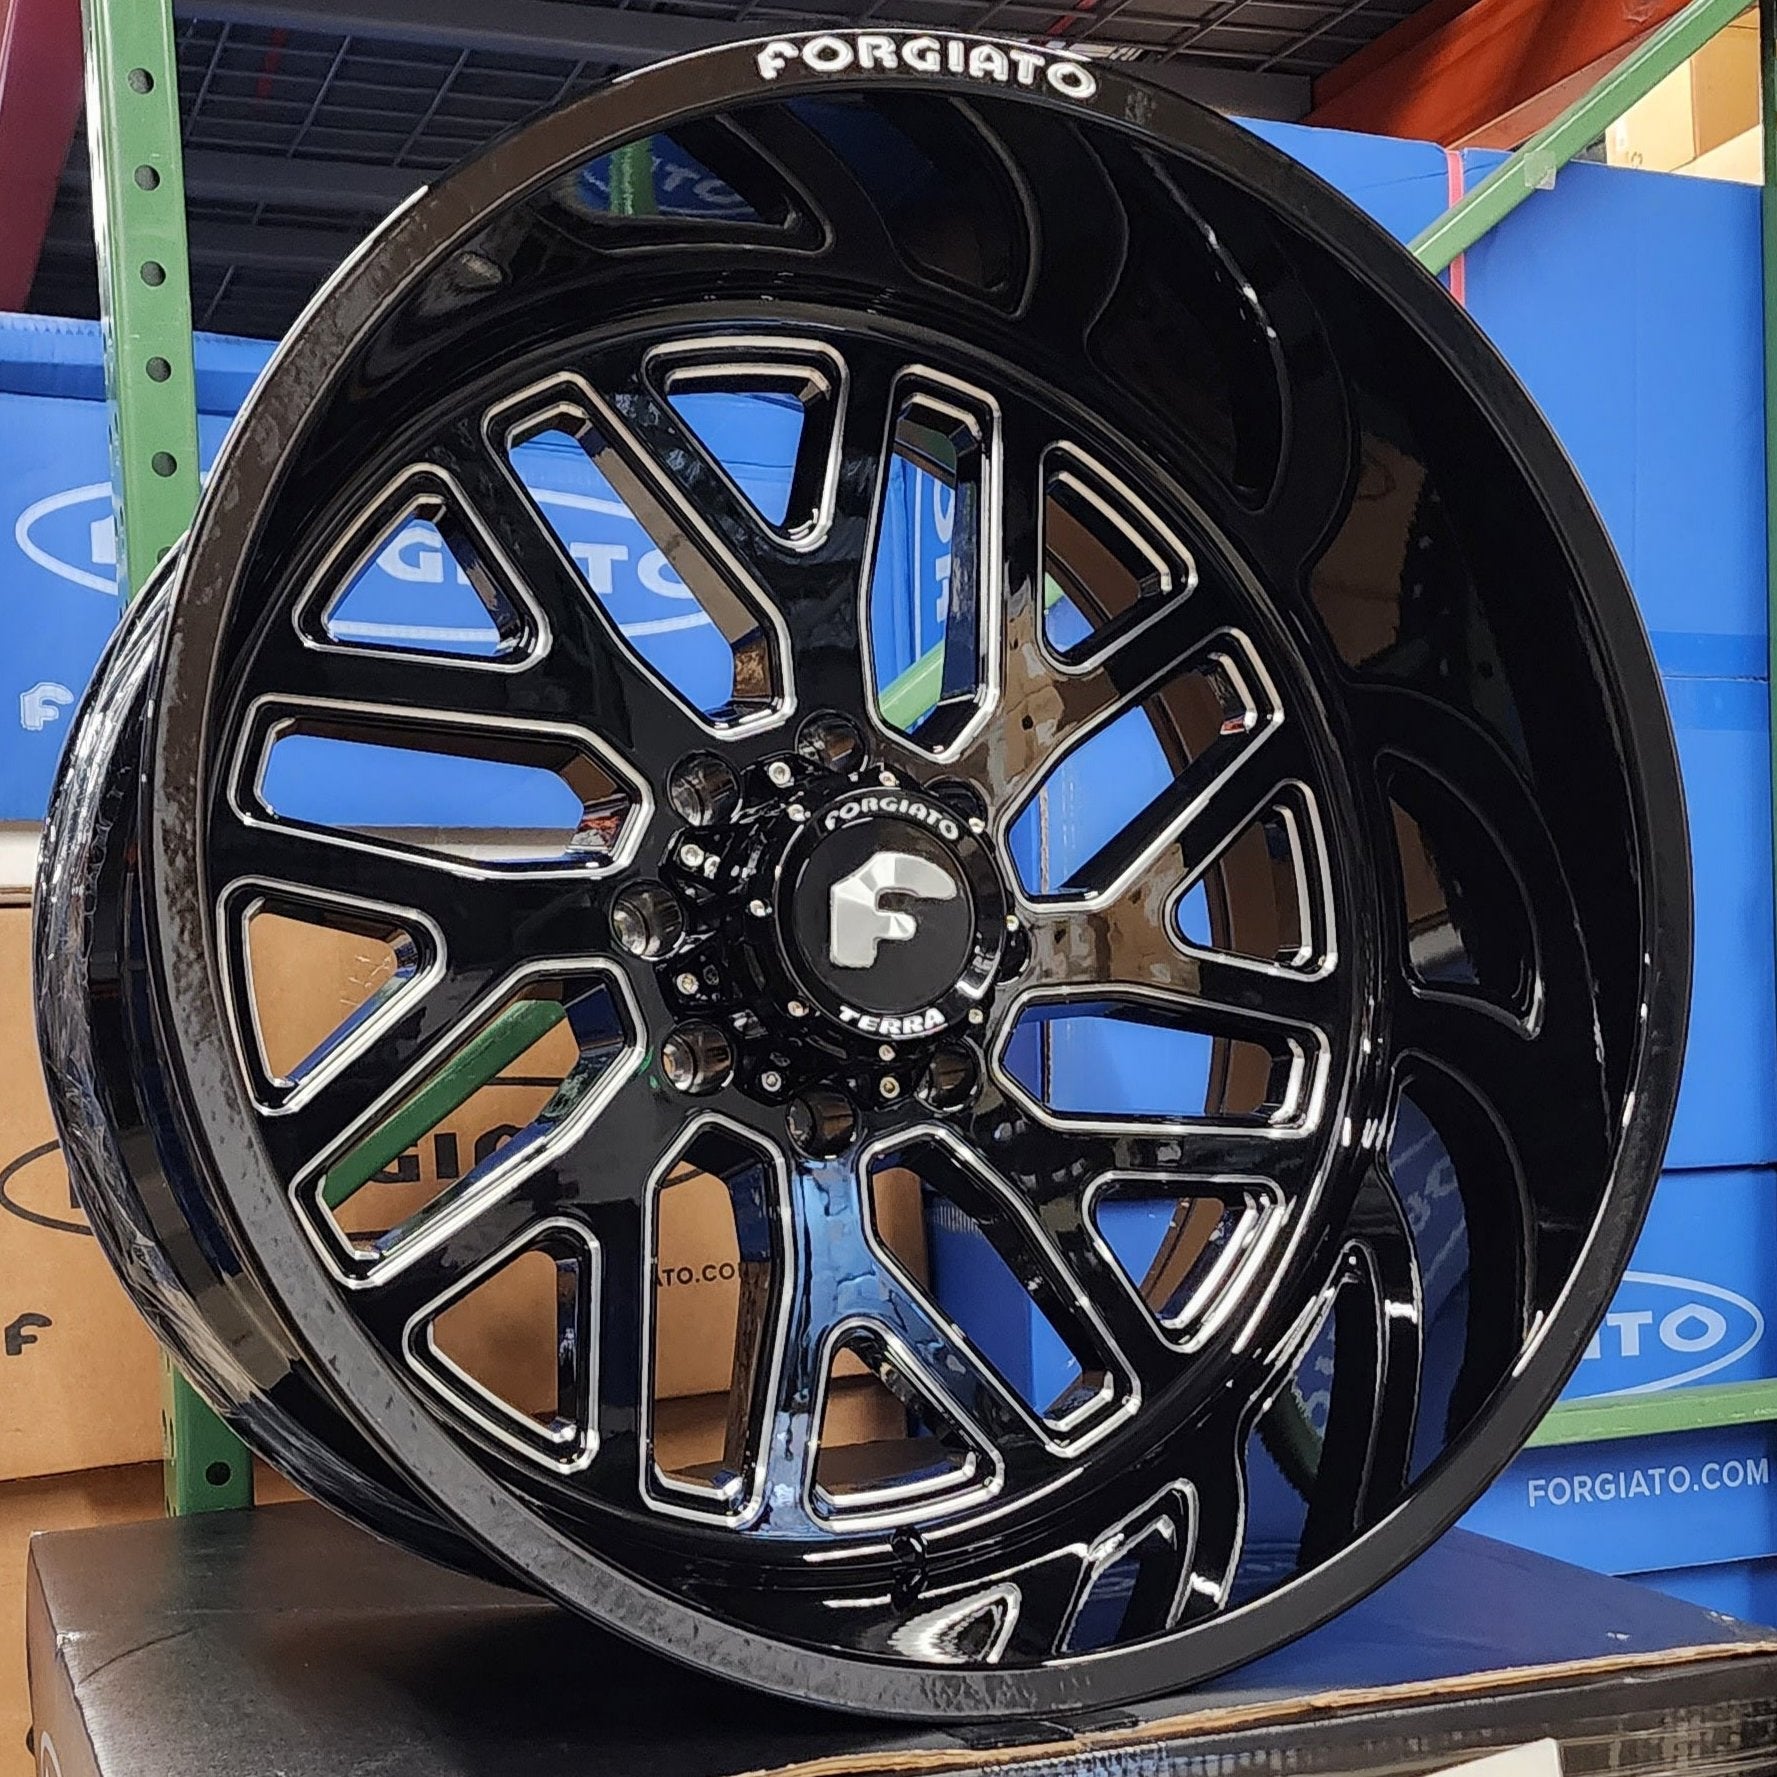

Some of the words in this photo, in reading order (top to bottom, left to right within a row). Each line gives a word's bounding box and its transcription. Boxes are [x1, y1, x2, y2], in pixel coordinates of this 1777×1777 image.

[757, 36, 1098, 100] FORGIATO
[20, 682, 74, 731] F
[825, 797, 959, 841] FORGIATO
[829, 851, 957, 968] F
[839, 1005, 946, 1035] TERRA
[656, 1262, 742, 1287] TO.CO
[4, 1312, 53, 1356] F
[1527, 1457, 1769, 1508] FORGIATO.COM
